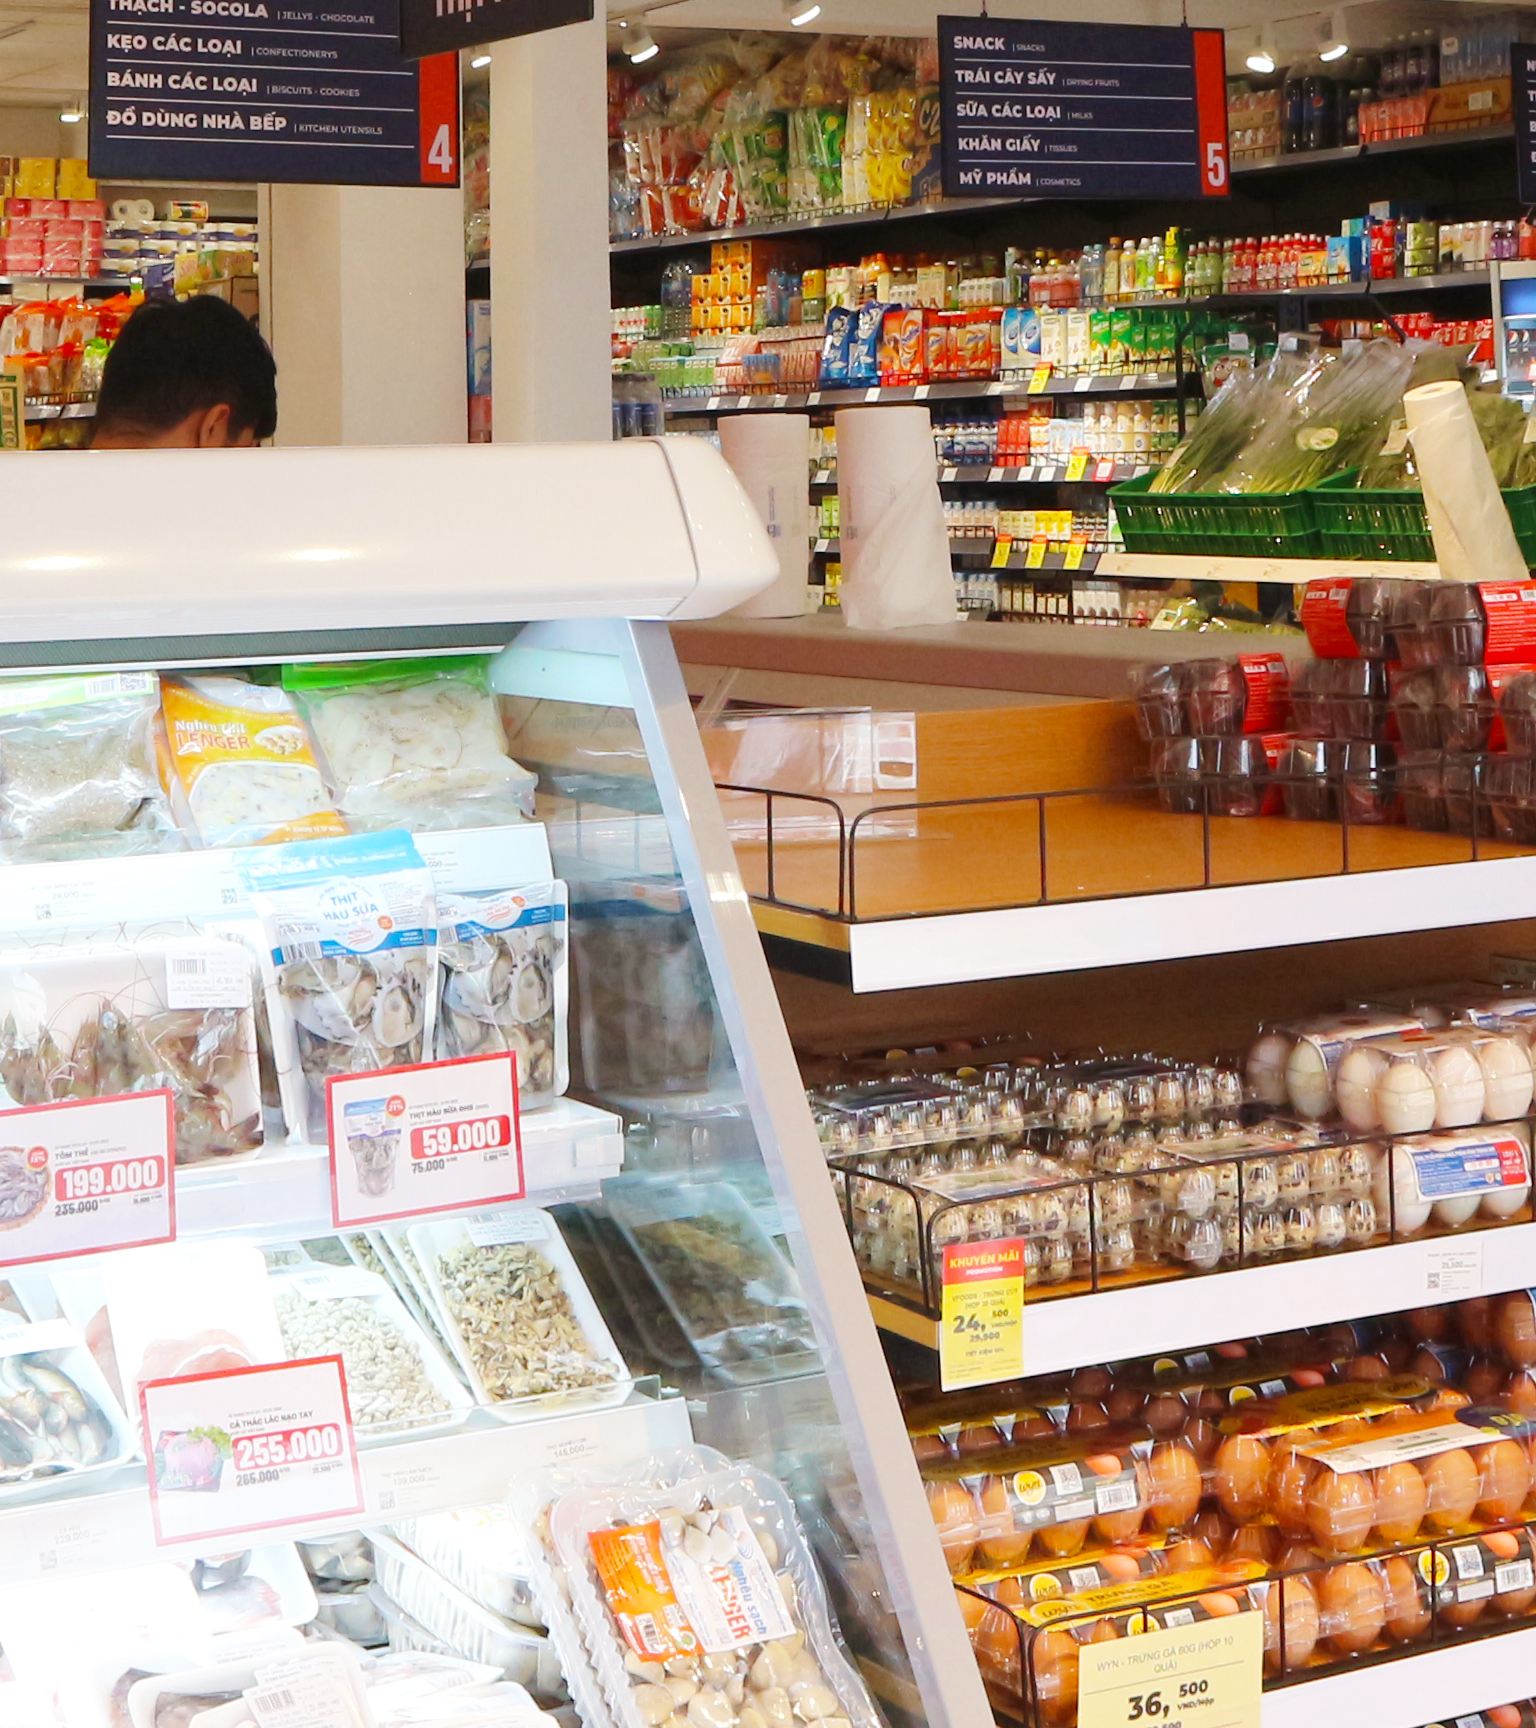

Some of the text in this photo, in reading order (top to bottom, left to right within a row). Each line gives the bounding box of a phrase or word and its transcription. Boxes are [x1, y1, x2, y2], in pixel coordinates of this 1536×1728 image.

[190, 0, 269, 19] SOCOLA
[320, 13, 375, 24] CHOCOLATE
[107, 34, 147, 54] KẸO
[152, 33, 192, 53] CÁC
[197, 37, 242, 58] LOẠI
[954, 36, 1005, 51] SNACK
[107, 70, 163, 89] BÁNH
[168, 72, 207, 91] CÁC
[213, 75, 257, 96] LOẠI
[320, 88, 360, 97] COOKIES
[955, 68, 990, 84] TRÁI
[994, 68, 1023, 84] CÂY
[1027, 68, 1056, 85] SẤY
[106, 107, 137, 126] ĐỒ
[142, 109, 198, 129] DÙNG
[203, 110, 245, 131] NHÀ
[250, 111, 287, 132] BẾP
[957, 101, 988, 117] SỮA
[992, 101, 1021, 118] CÁC
[1026, 105, 1061, 122] LOẠI
[428, 124, 453, 173] 4
[958, 137, 1002, 151] KHĂN
[1006, 134, 1040, 152] GIẤY
[959, 169, 982, 185] MỸ
[986, 167, 1031, 186] PHẨM
[1207, 143, 1225, 187] 5
[423, 1119, 501, 1156] 59.000
[63, 1159, 158, 1198] 199.000
[953, 1313, 986, 1333] 24,
[237, 1426, 339, 1469] 255.000
[1097, 1659, 1120, 1672] WYN
[1127, 1648, 1161, 1665] TRỨNG
[1163, 1645, 1177, 1658] GÀ
[1224, 1636, 1234, 1646] 10
[1128, 1679, 1209, 1721] 36, 500
